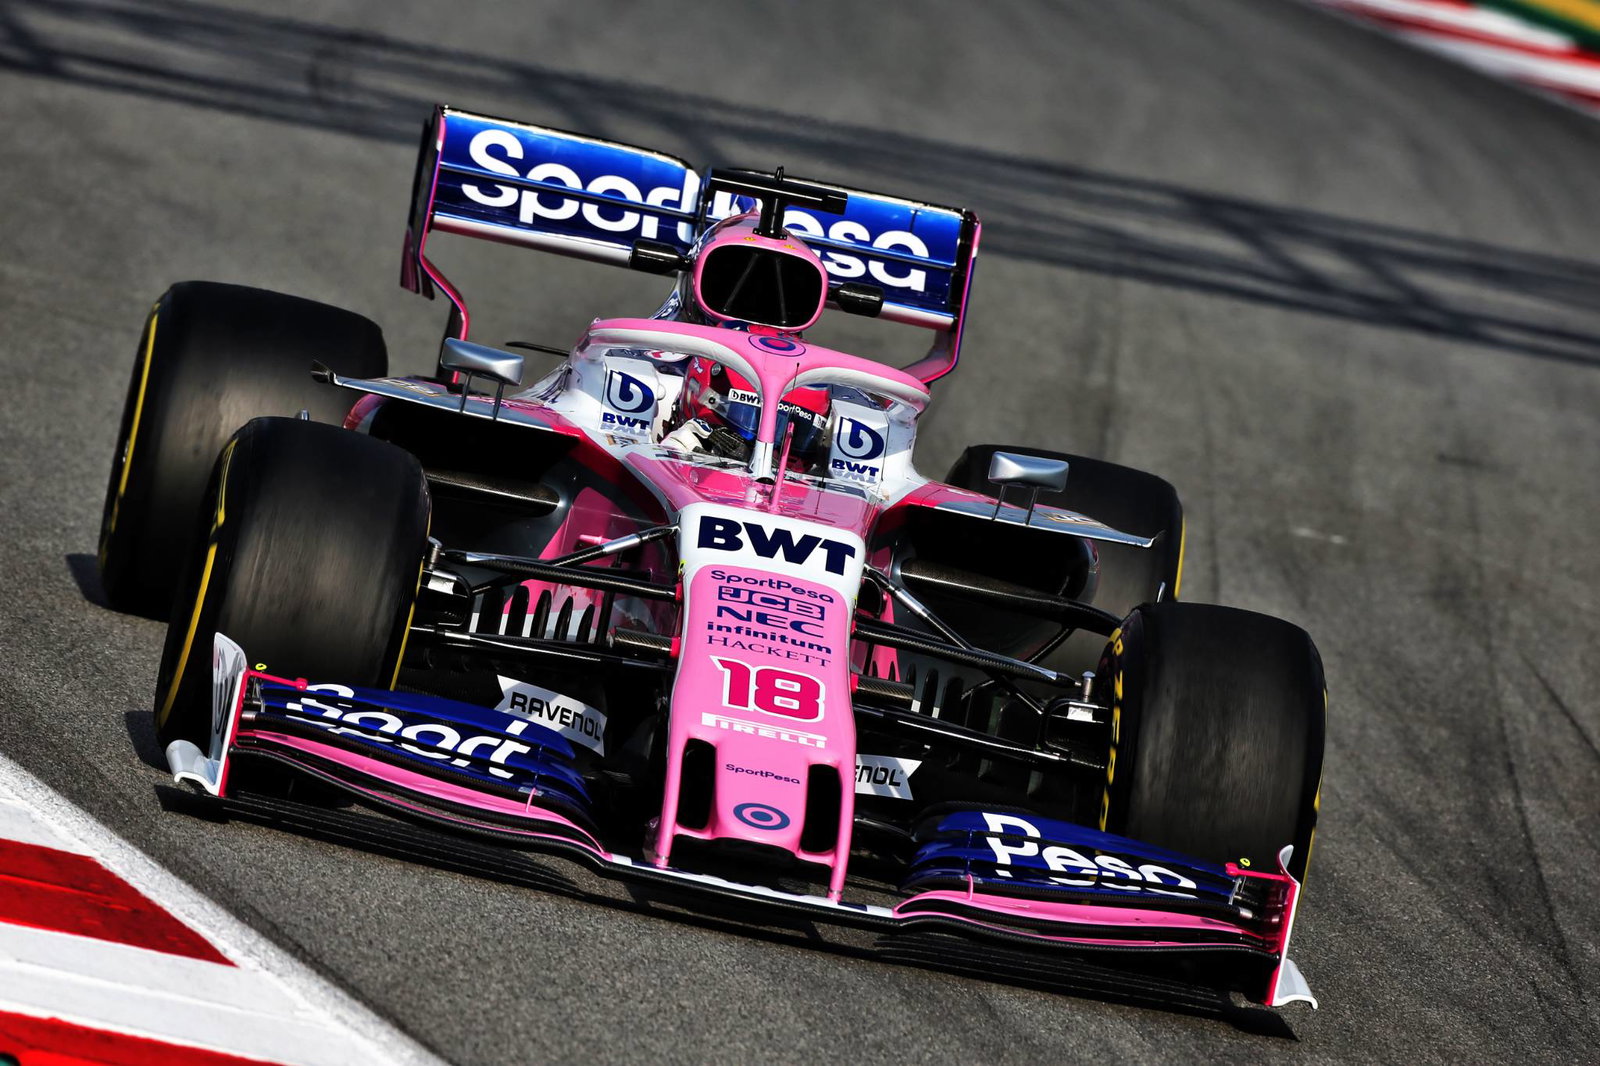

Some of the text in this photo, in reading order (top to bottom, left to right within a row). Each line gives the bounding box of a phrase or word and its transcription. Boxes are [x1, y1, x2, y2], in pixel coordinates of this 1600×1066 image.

[602, 412, 650, 430] BWT
[776, 402, 812, 421] portPesa
[831, 458, 880, 477] BWT
[697, 515, 856, 576] BWT
[710, 569, 835, 604] SportPesa
[718, 585, 825, 621] JCB
[707, 621, 832, 655] infinitum
[716, 605, 825, 639] NEC
[707, 635, 832, 667] HACKETT
[709, 655, 826, 723] 18
[285, 683, 532, 780] Sport
[509, 691, 603, 742] RAVENOL
[701, 712, 828, 749] PIRELLI
[725, 763, 801, 785] SportPesa
[981, 812, 1198, 900] Pesa
